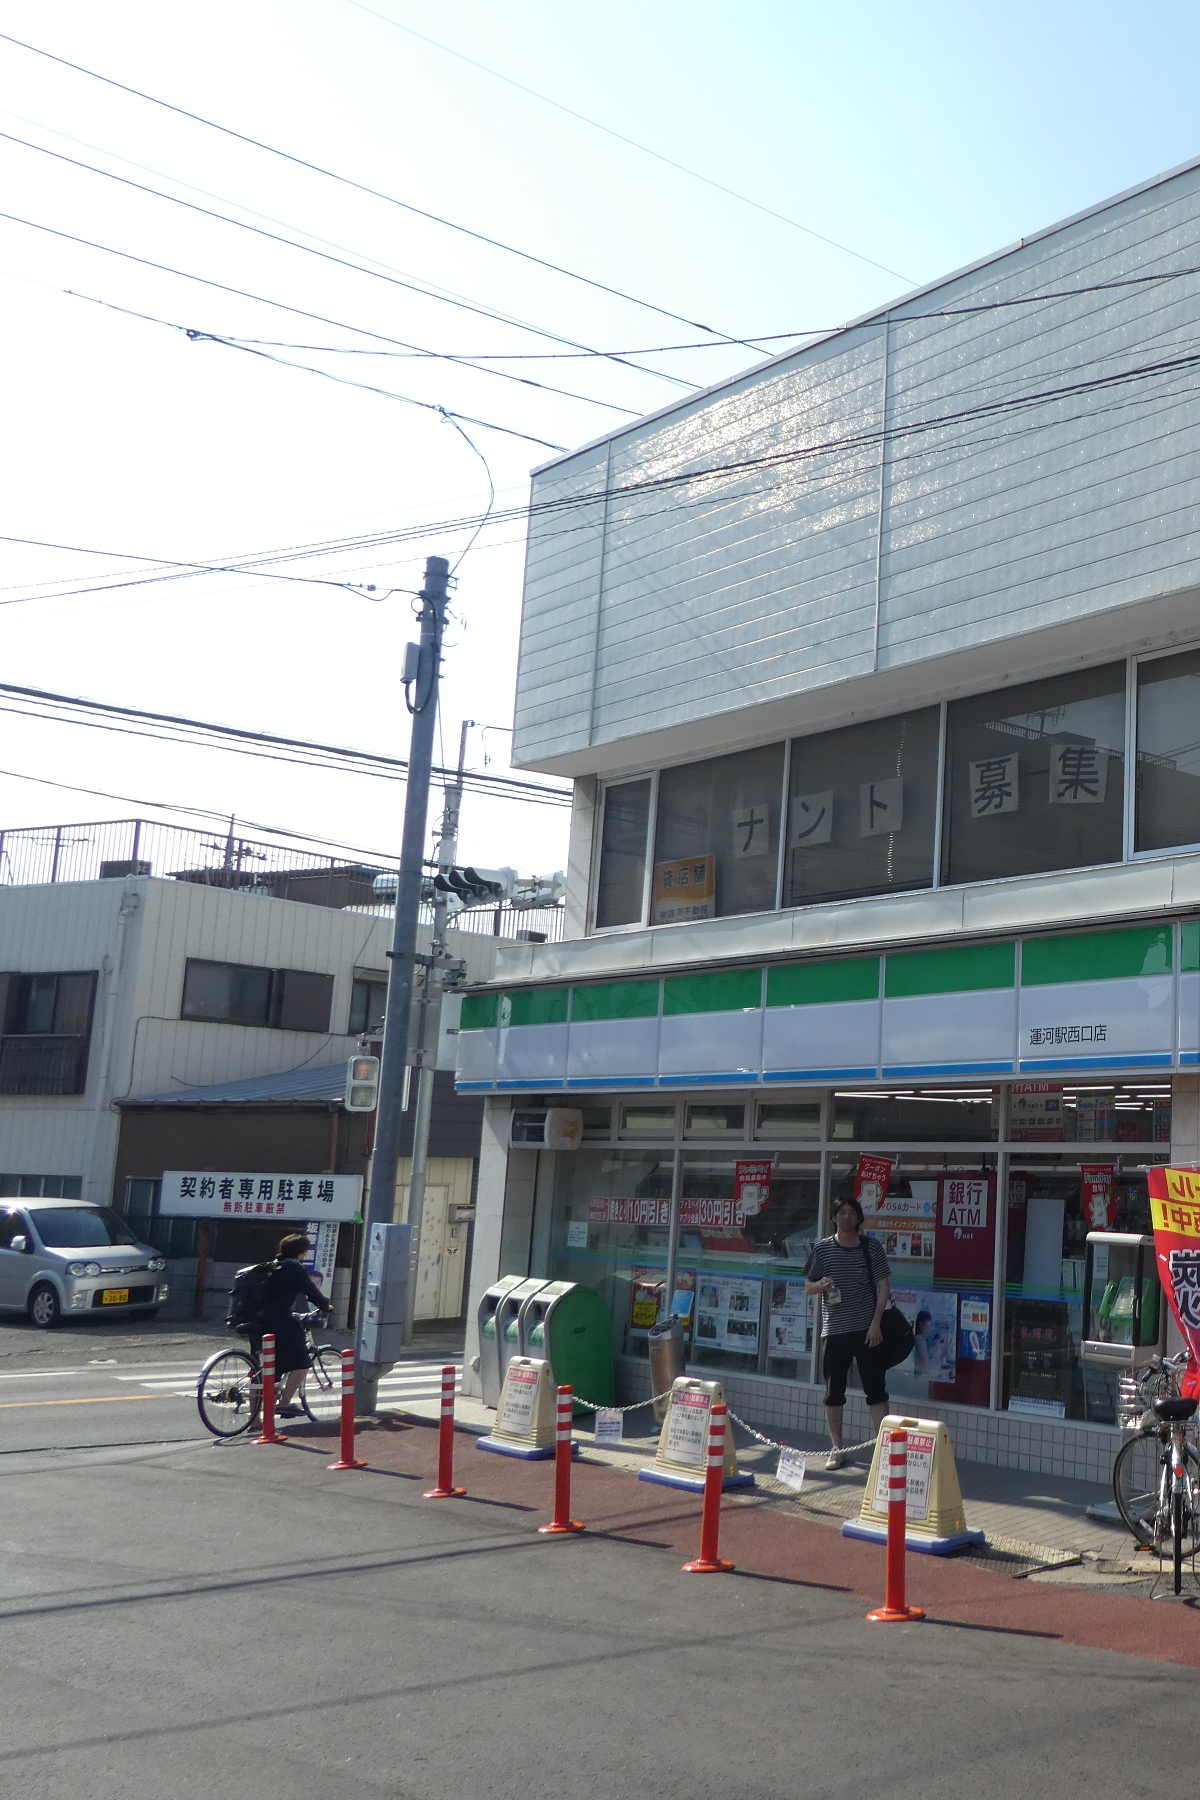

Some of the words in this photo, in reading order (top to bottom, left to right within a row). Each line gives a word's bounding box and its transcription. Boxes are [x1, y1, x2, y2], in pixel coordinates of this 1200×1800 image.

[662, 863, 707, 890] 貸店舗
[1029, 1023, 1107, 1046] 運河駅西口店
[738, 1164, 770, 1175] ファミペイ
[864, 1163, 886, 1172] クーポン
[860, 1171, 886, 1181] あげちゃう
[1083, 1172, 1112, 1184] FamiPay
[180, 1176, 335, 1203] 契約者専用駐車場
[948, 1181, 983, 1206] 銀行
[222, 1201, 287, 1214] 無断駐車厳禁
[947, 1208, 981, 1226] ATM
[971, 1312, 988, 1323] 無料
